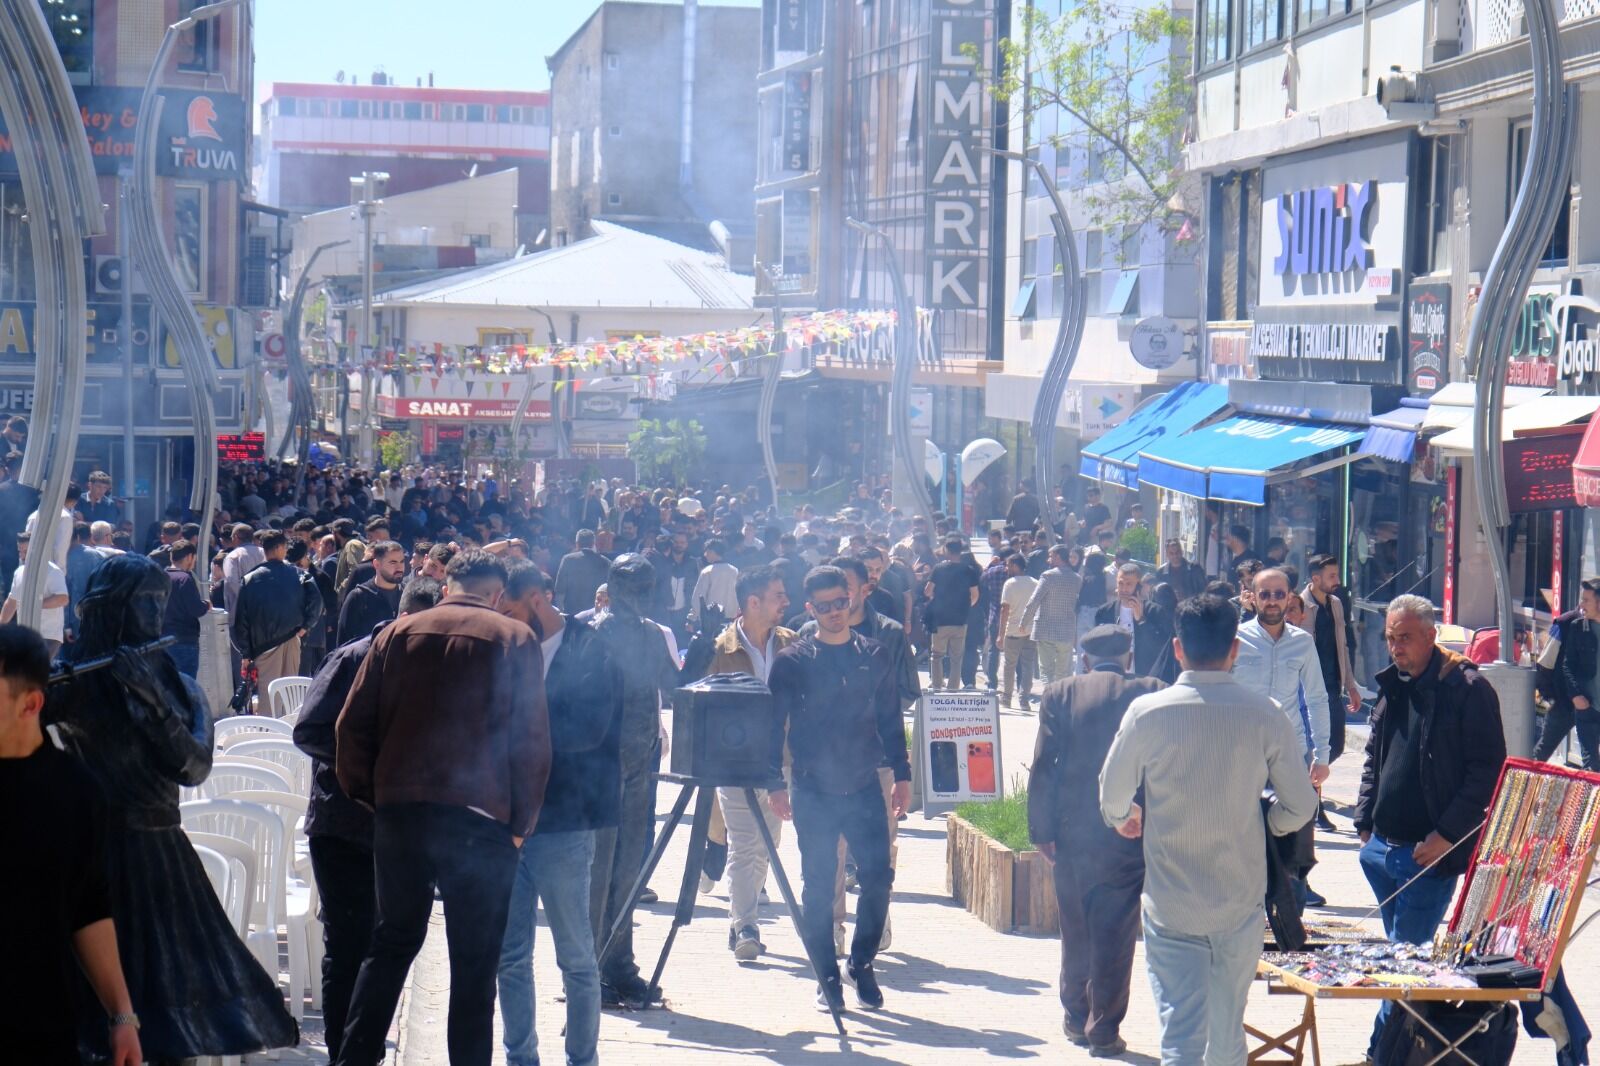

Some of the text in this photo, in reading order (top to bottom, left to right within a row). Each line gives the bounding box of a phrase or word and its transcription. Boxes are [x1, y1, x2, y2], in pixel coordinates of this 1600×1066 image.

[171, 147, 237, 170] TRUVA
[932, 0, 981, 305] LMARK
[1250, 323, 1289, 357] AKSESUAR
[1291, 324, 1299, 359] &
[1347, 324, 1389, 362] MARKET
[408, 401, 472, 416] SANAT
[477, 423, 540, 437] SAAT
[930, 725, 993, 740] DÖNÜŞTÜRÜYORUZ
